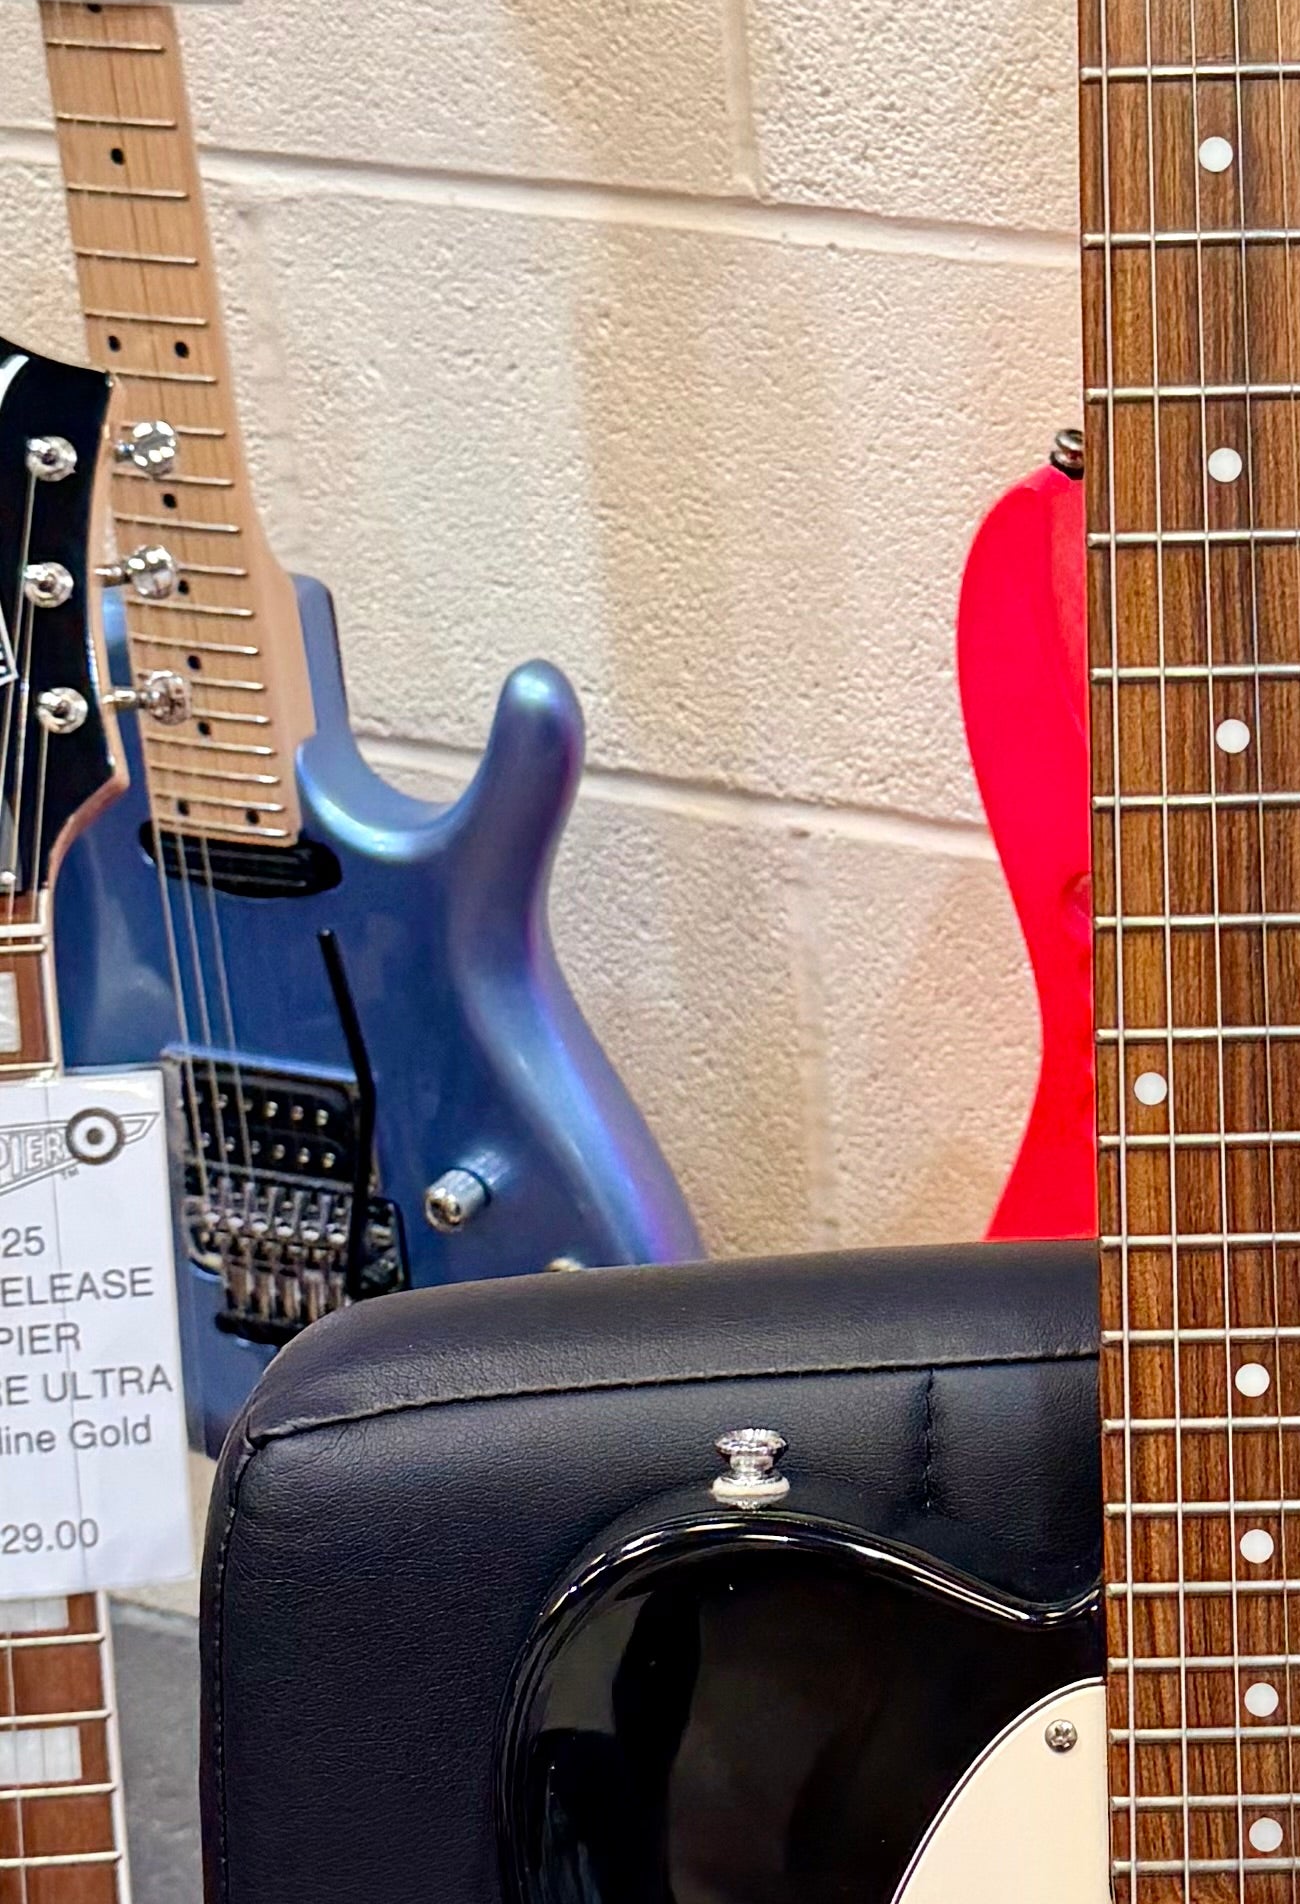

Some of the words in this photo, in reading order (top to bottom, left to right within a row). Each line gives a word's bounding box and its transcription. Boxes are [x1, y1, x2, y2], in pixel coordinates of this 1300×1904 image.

[2, 1225, 46, 1258] 25
[0, 1266, 154, 1308] ELEASE
[0, 1374, 30, 1407] E
[43, 1364, 173, 1404] ULTRA
[69, 1414, 153, 1451] Gold
[1, 1519, 99, 1555] 29.00
